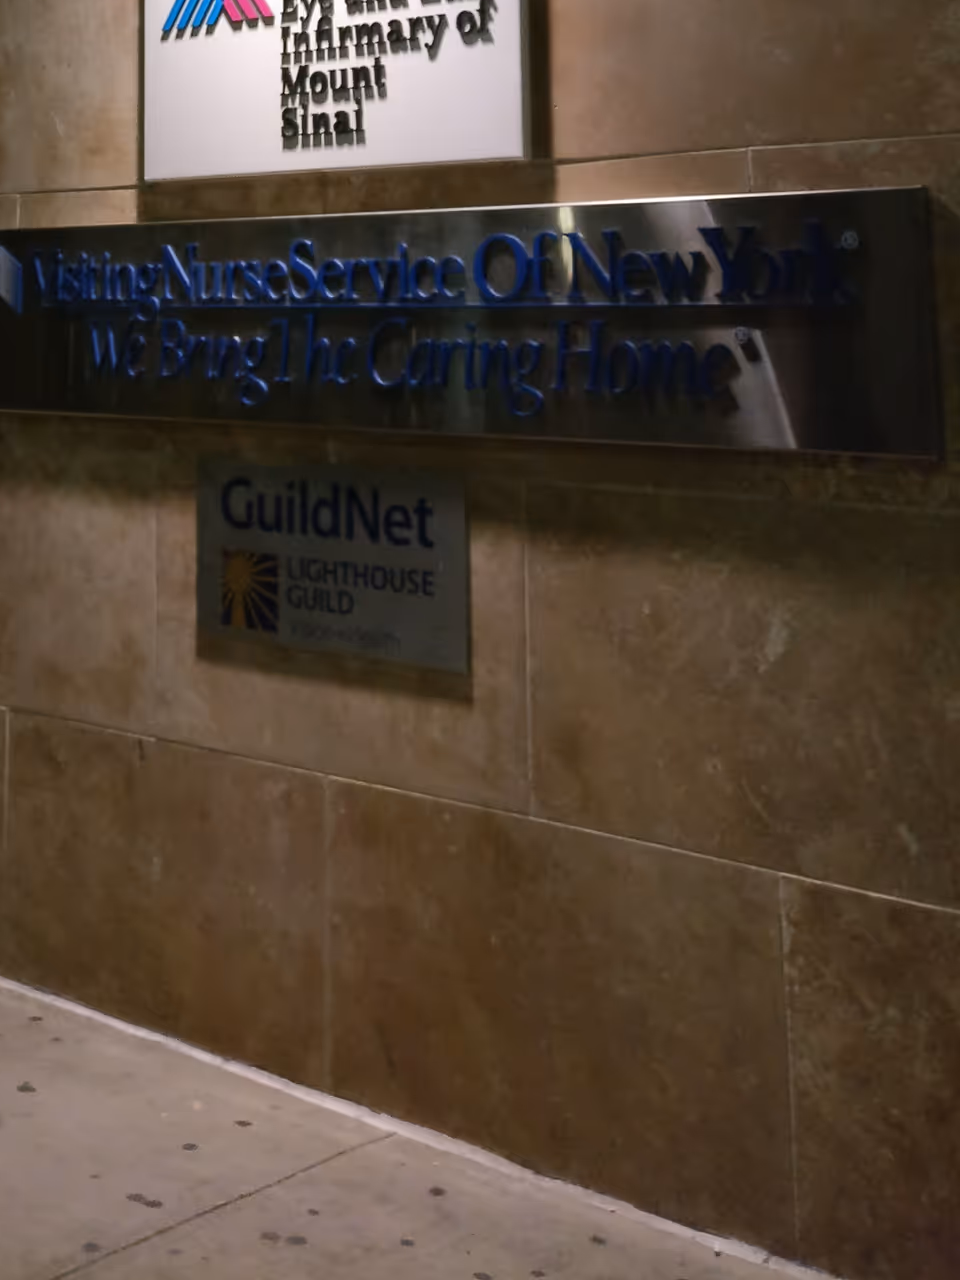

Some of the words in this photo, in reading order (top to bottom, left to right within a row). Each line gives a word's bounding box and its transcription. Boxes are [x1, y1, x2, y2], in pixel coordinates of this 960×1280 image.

[281, 11, 448, 61] Infirmary
[281, 58, 386, 102] Mount
[281, 100, 365, 145] Sinai
[89, 319, 147, 380] We
[159, 318, 270, 407] Bring
[268, 313, 358, 387] The
[367, 318, 545, 418] Caring
[221, 478, 434, 548] GuildNet
[287, 556, 435, 596] LIGHTHOUSE
[287, 584, 355, 615] GUILD
